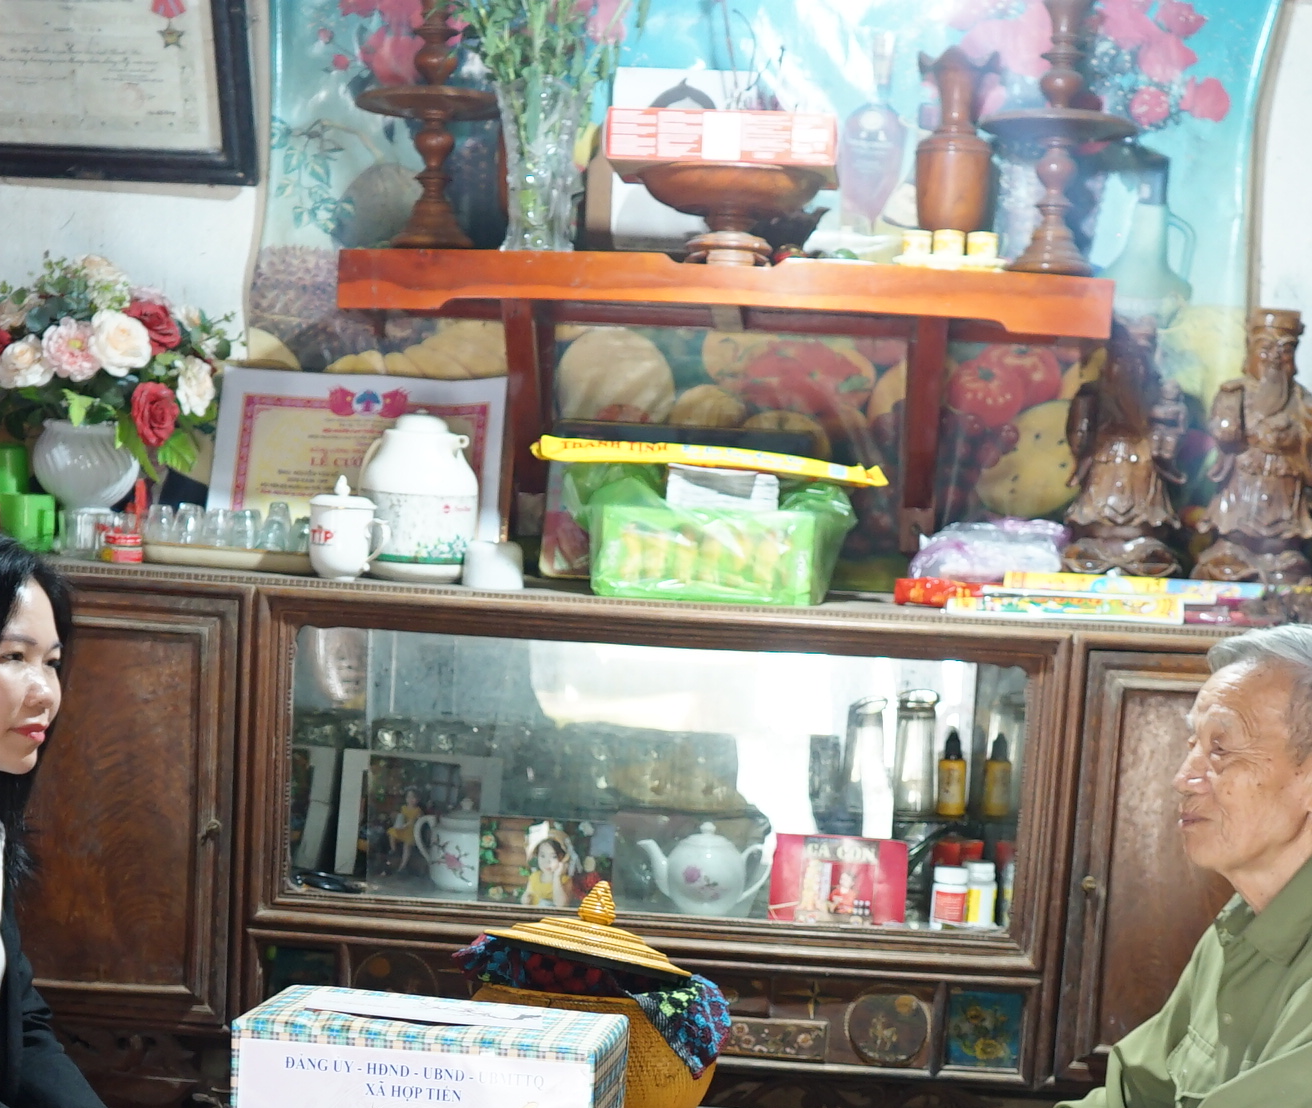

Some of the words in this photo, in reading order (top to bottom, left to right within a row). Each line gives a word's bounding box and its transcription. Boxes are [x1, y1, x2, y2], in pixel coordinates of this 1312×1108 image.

[285, 1054, 329, 1072] ĐẢNG
[366, 1061, 411, 1079] HĐND
[423, 1066, 465, 1083] UBND
[365, 1080, 386, 1097] XÃ
[390, 1085, 423, 1102] HỢP
